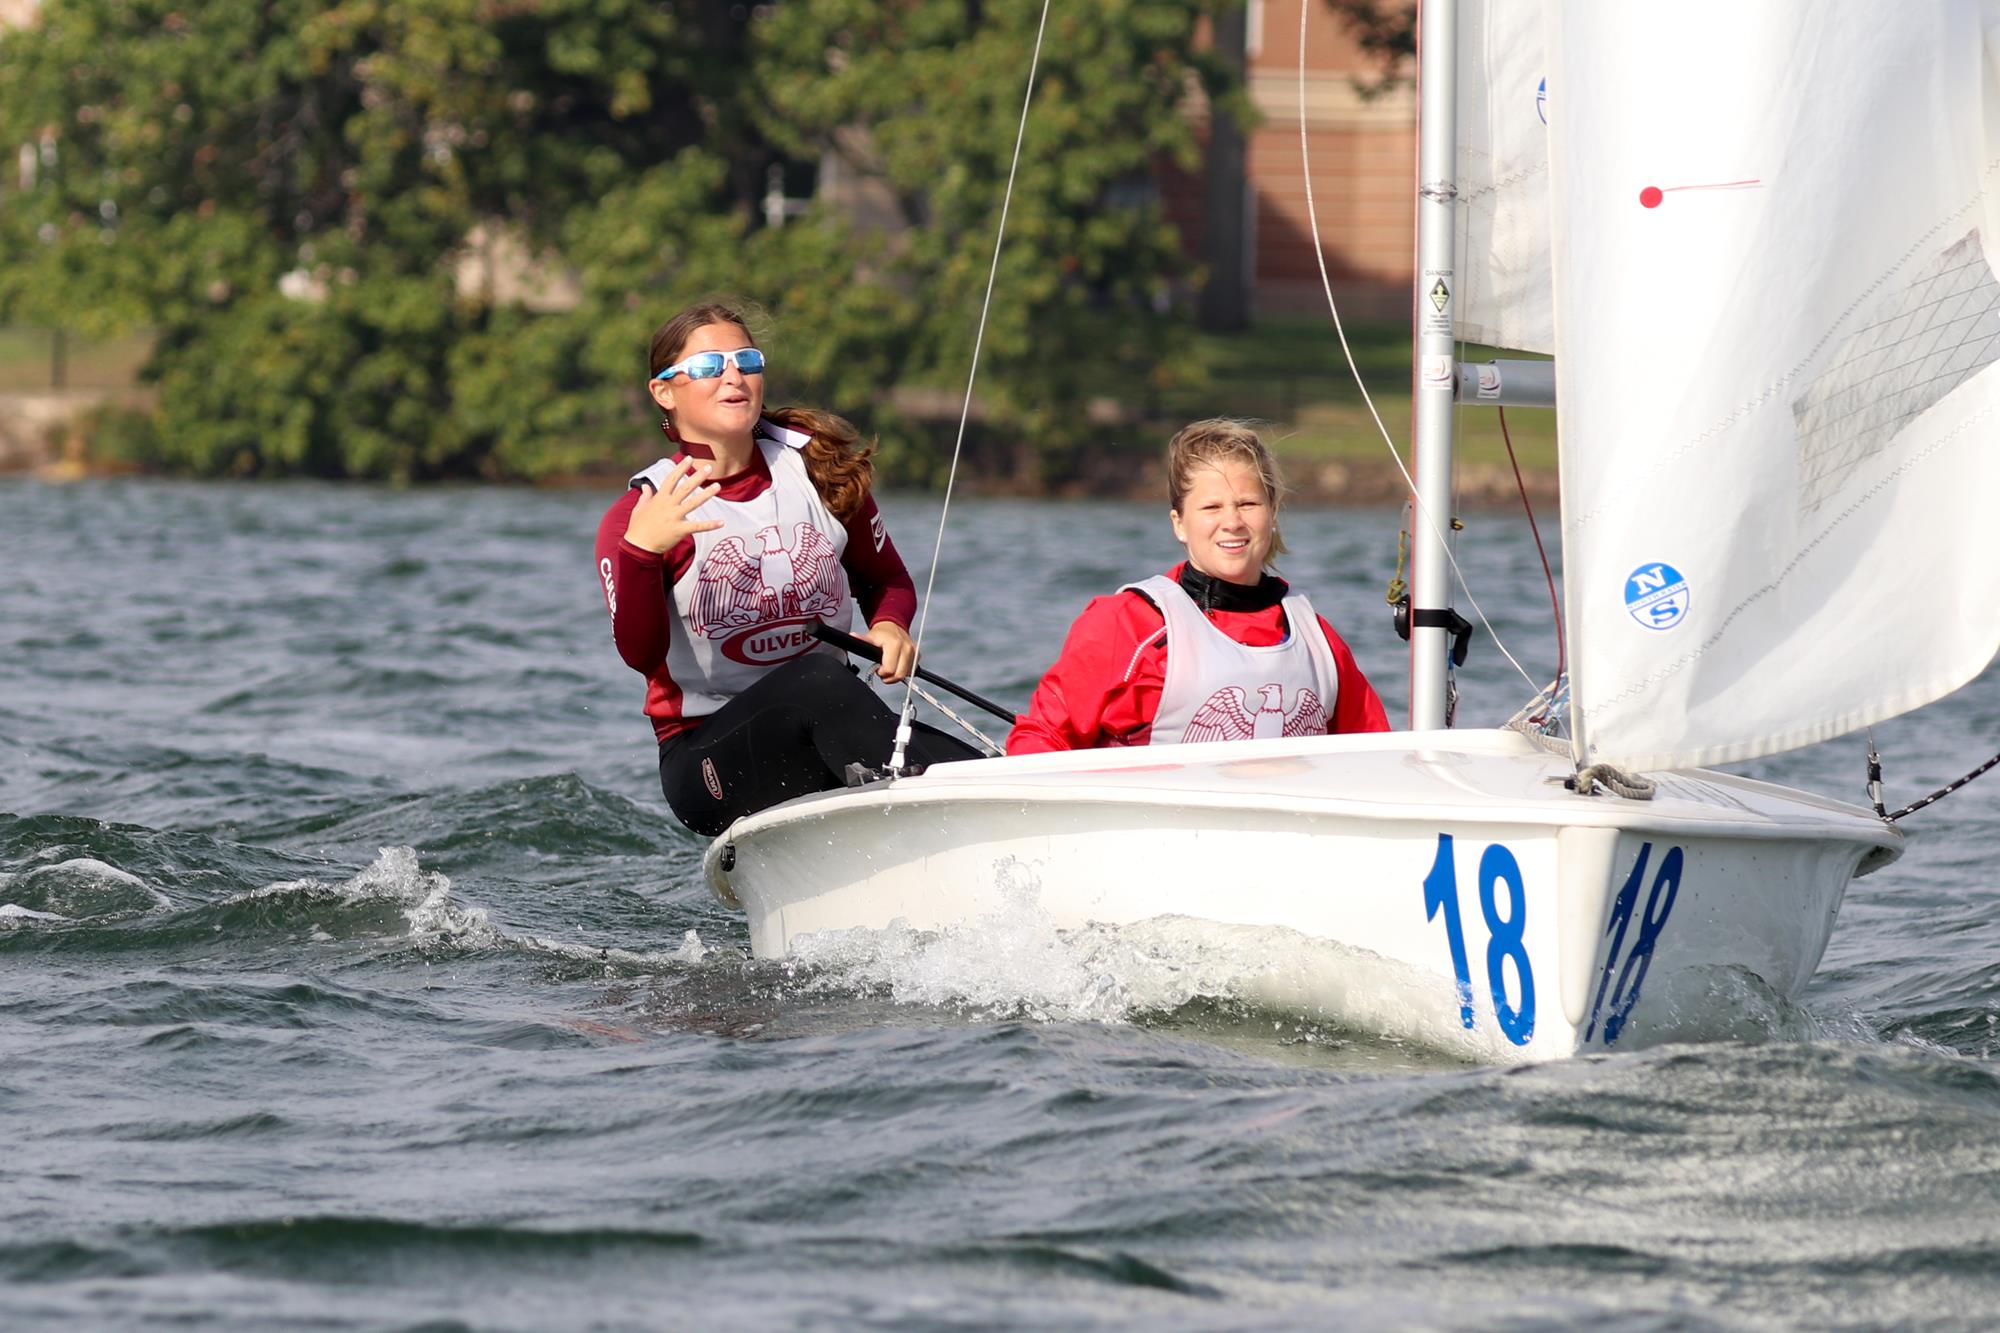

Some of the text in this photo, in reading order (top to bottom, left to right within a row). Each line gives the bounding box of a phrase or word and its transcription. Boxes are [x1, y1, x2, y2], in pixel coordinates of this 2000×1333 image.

[1649, 598, 1680, 625] S
[1423, 832, 1536, 1046] 18
[1585, 842, 1684, 1047] 18
